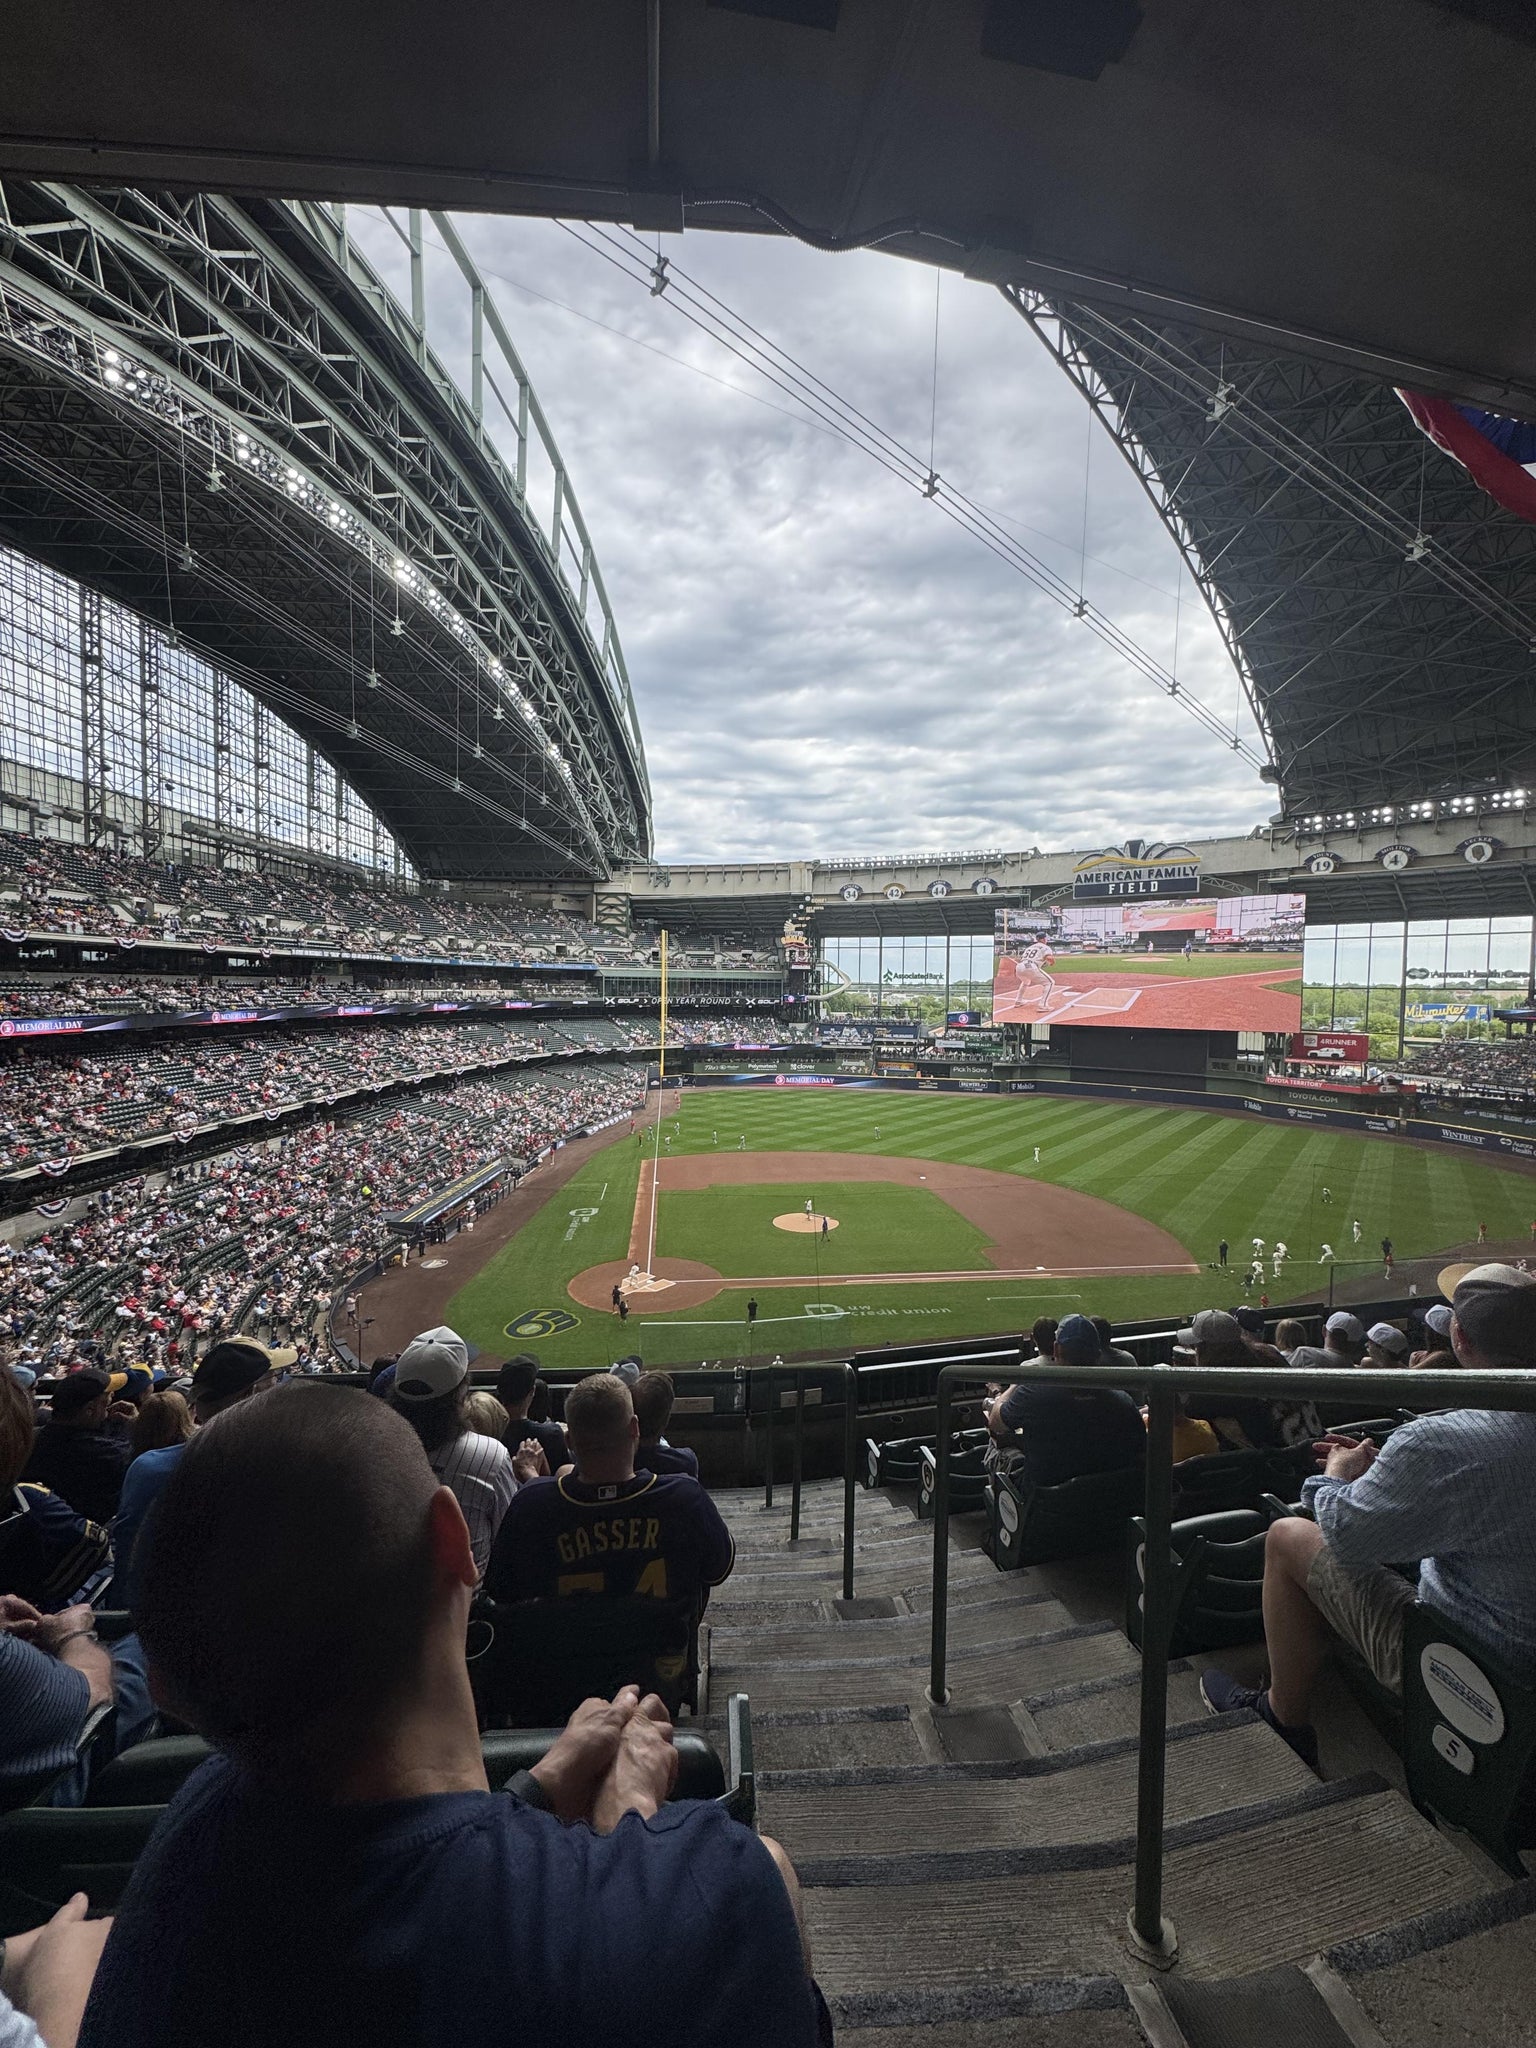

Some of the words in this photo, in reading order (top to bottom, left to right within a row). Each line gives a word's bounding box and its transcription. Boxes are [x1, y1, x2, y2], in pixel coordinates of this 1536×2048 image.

[1314, 860, 1331, 872] 19
[1389, 854, 1399, 866] 4
[1074, 869, 1142, 884] AMERICAN
[1147, 866, 1198, 879] FAMILY
[845, 890, 857, 898] 34
[888, 889, 900, 897] 42
[933, 887, 945, 896] 44
[1108, 881, 1159, 895] FIELD
[651, 997, 673, 1005] OPN
[700, 997, 731, 1005] ROUND
[16, 1021, 64, 1032] MEMORIAL
[65, 1020, 83, 1030] DAY
[1319, 1038, 1357, 1046] 4RUNNER
[1289, 1079, 1323, 1088] TERRITORY
[1288, 1092, 1338, 1104] TOYOTA.COM
[1441, 1128, 1486, 1143] WINTRUST
[851, 1308, 899, 1316] credit
[902, 1306, 953, 1315] union
[556, 1517, 660, 1564] GASSER
[1446, 1739, 1461, 1758] 5
